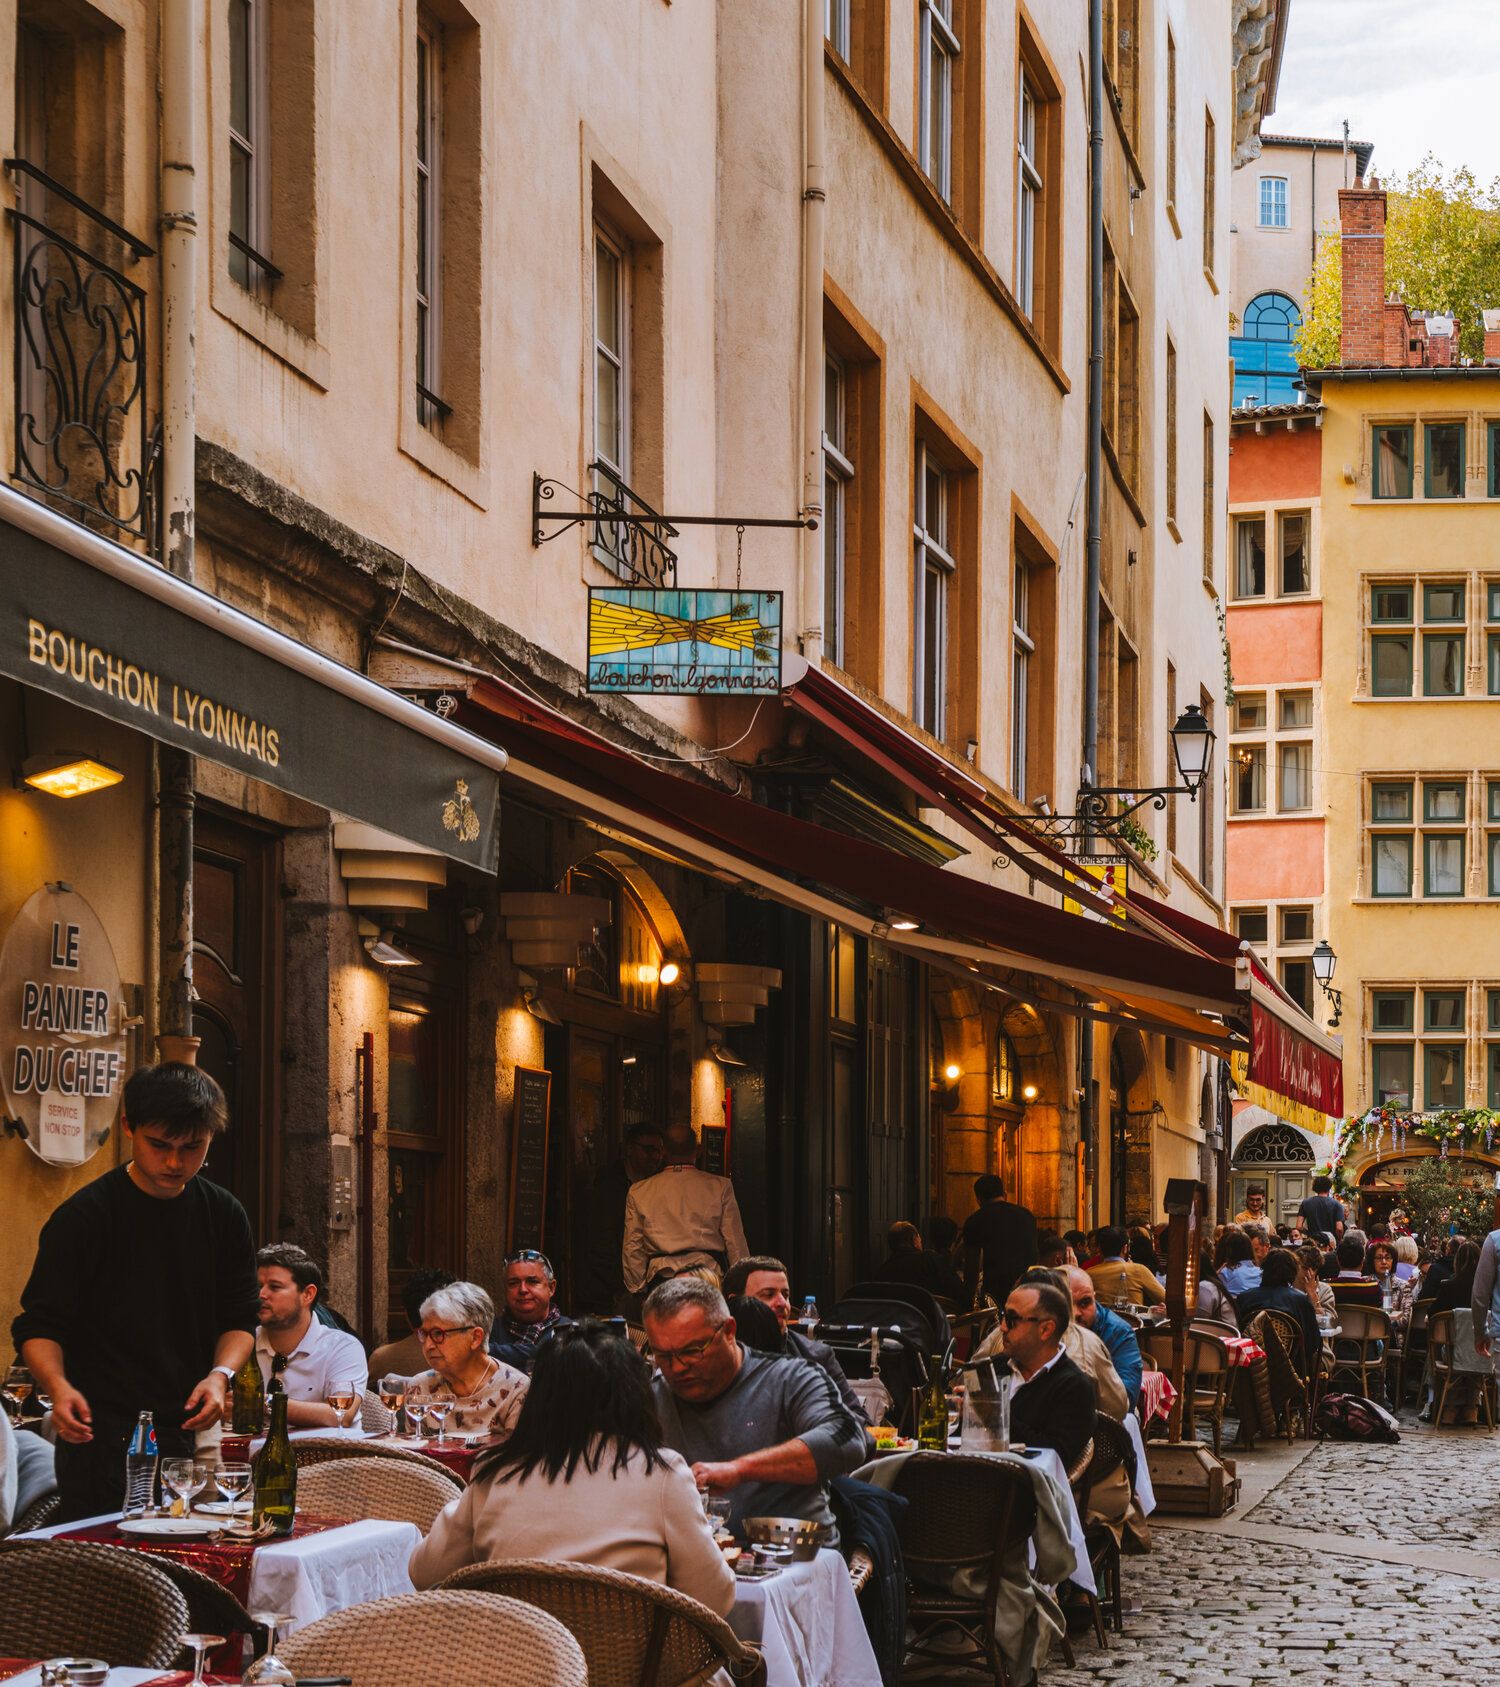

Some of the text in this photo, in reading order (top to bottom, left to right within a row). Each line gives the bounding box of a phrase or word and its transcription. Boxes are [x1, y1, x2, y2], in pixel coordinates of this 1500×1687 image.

[28, 618, 280, 768] BOUCHON LYONNAIS
[591, 663, 780, 694] bouchon lyonnais
[51, 921, 80, 970] LE
[22, 980, 109, 1036] PANIER
[13, 1045, 120, 1097] DU CHEF
[44, 1120, 81, 1138] NON STOP
[47, 1103, 79, 1120] SERVICE
